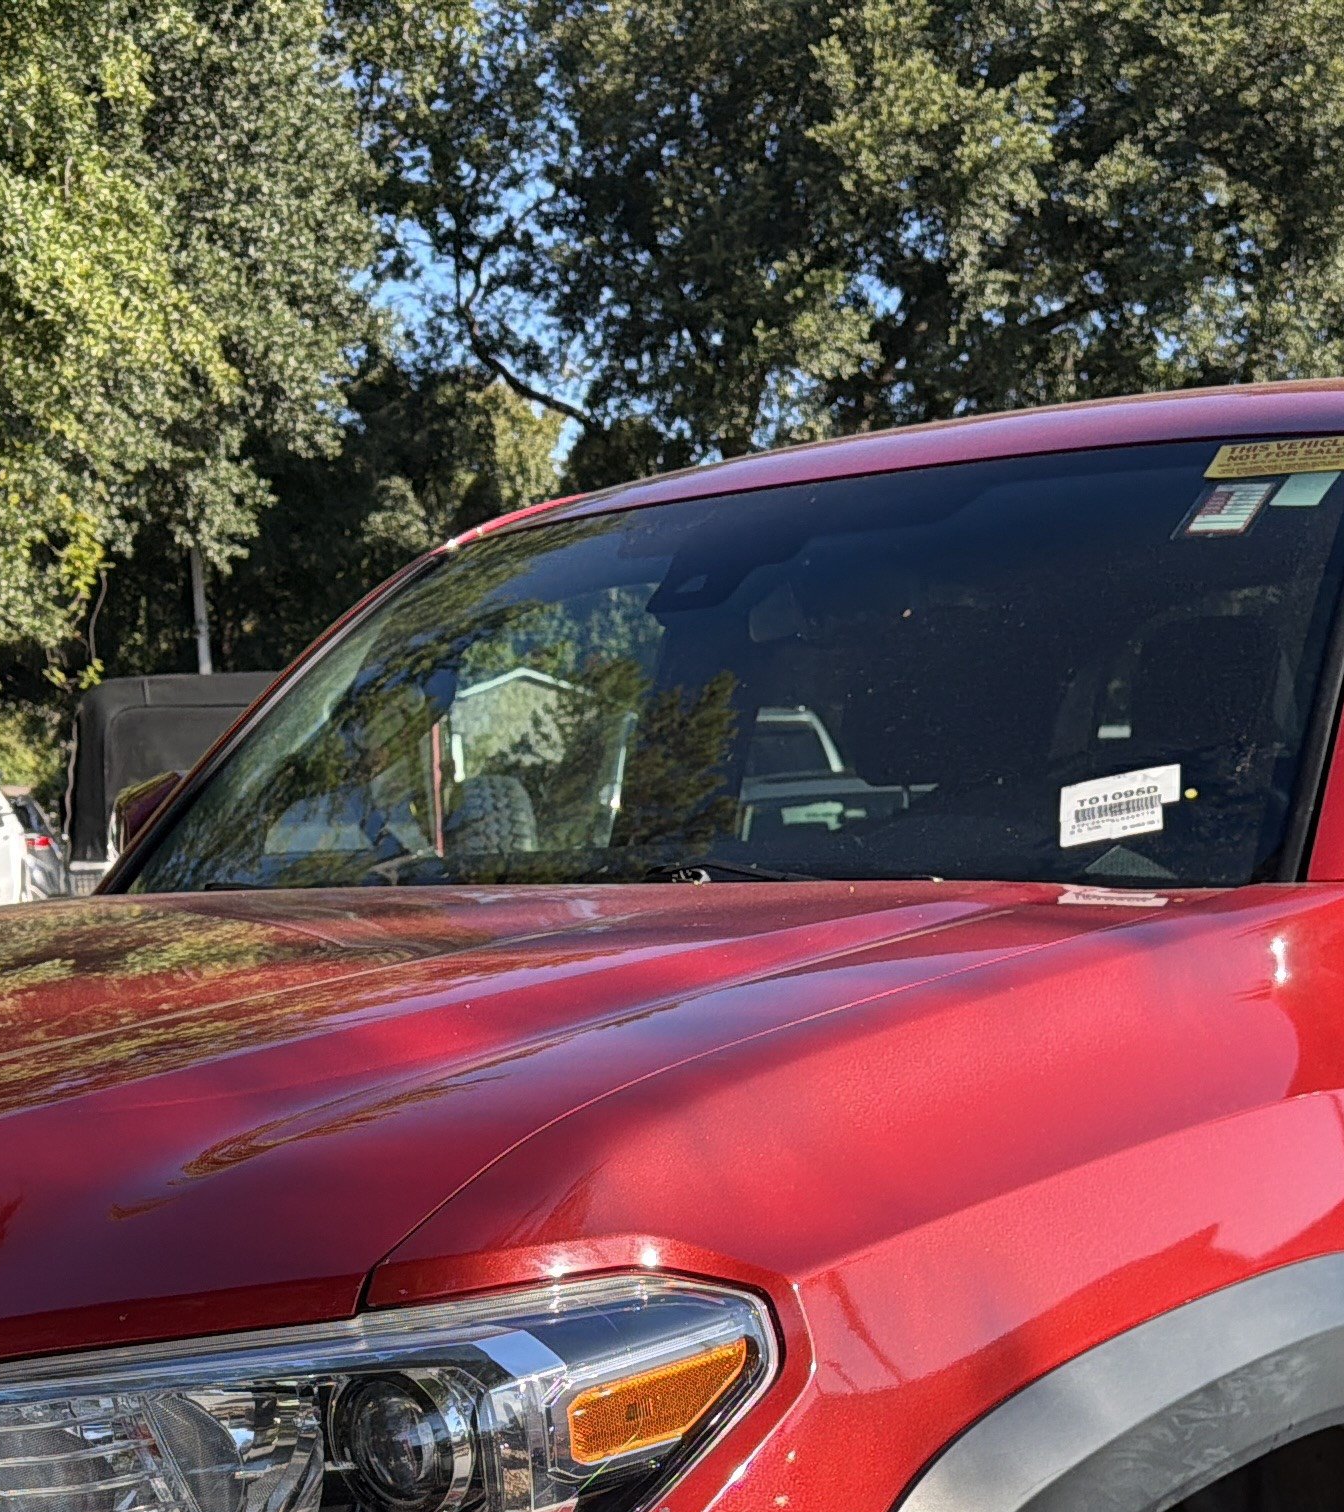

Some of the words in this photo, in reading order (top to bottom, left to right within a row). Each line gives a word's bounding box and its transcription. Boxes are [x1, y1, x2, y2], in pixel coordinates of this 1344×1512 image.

[1230, 443, 1270, 454] THIS
[1226, 453, 1260, 462] NOT
[1264, 449, 1299, 459] FOR
